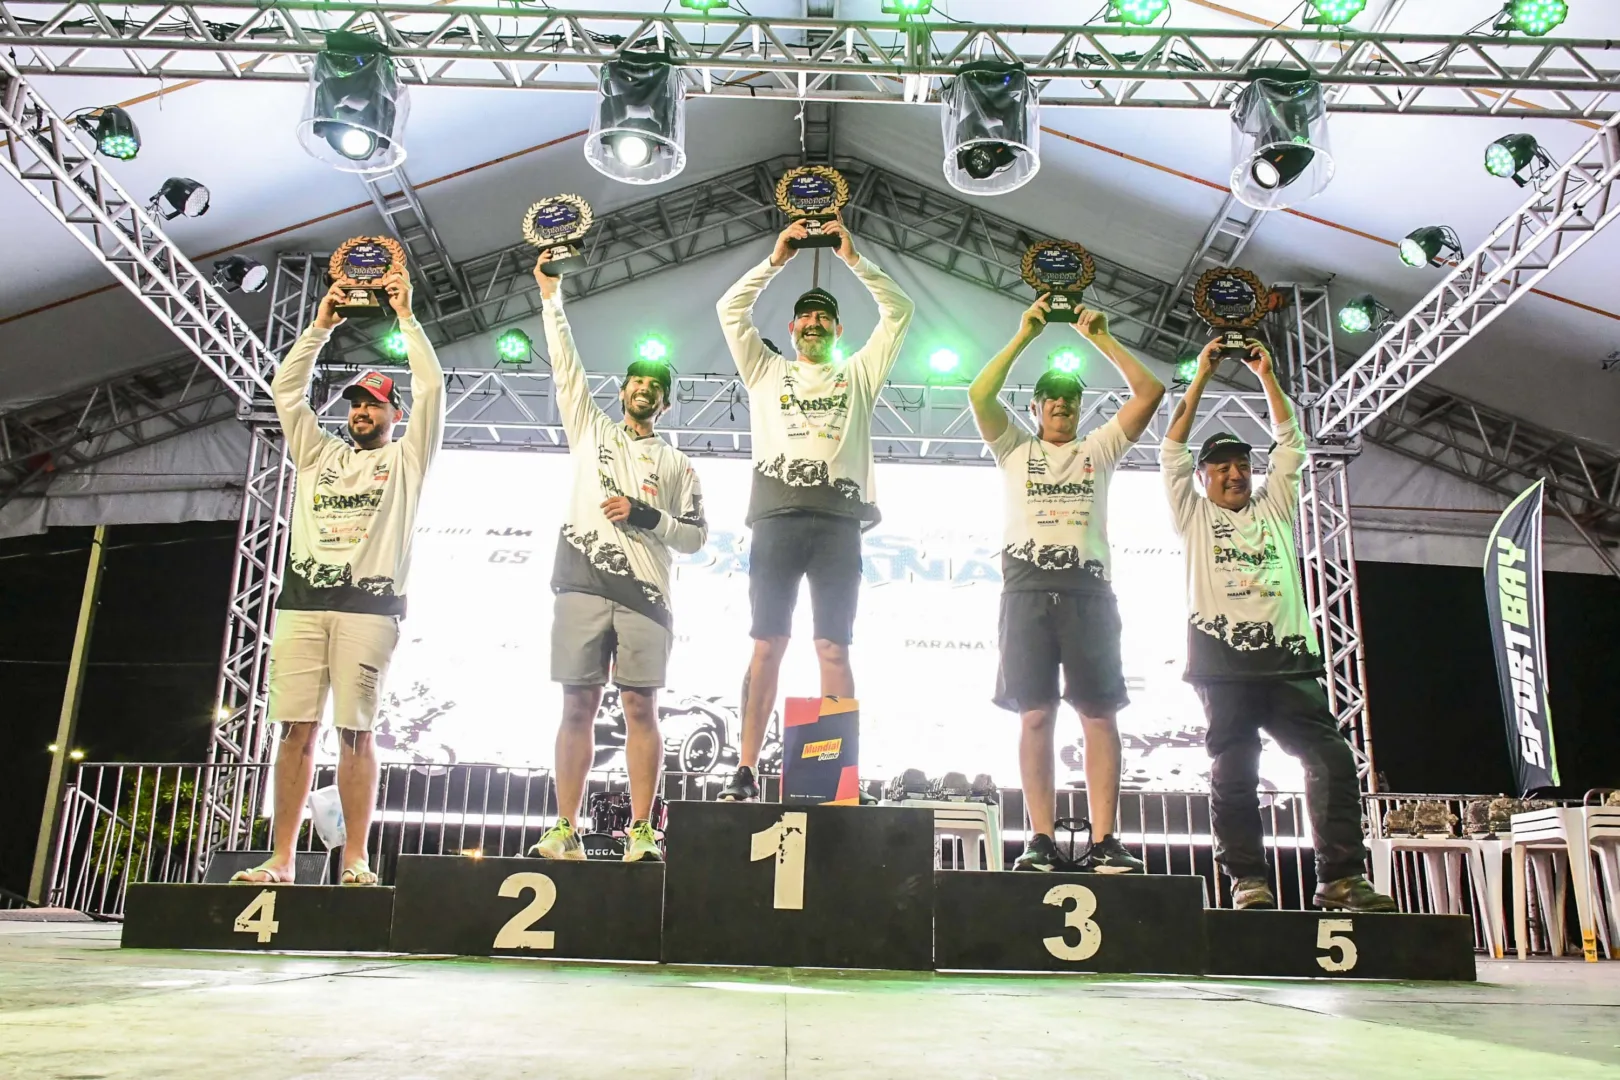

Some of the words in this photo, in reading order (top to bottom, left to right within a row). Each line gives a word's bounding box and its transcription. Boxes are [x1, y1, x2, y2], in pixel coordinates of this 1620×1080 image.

[488, 549, 533, 565] GS
[1498, 536, 1546, 770] SPORTBAY
[804, 740, 840, 755] Mundial
[585, 848, 623, 856] OGGA
[750, 811, 808, 910] 1
[234, 889, 280, 943] 4
[493, 871, 557, 950] 2
[1042, 883, 1102, 961] 3
[1316, 918, 1358, 972] 5
